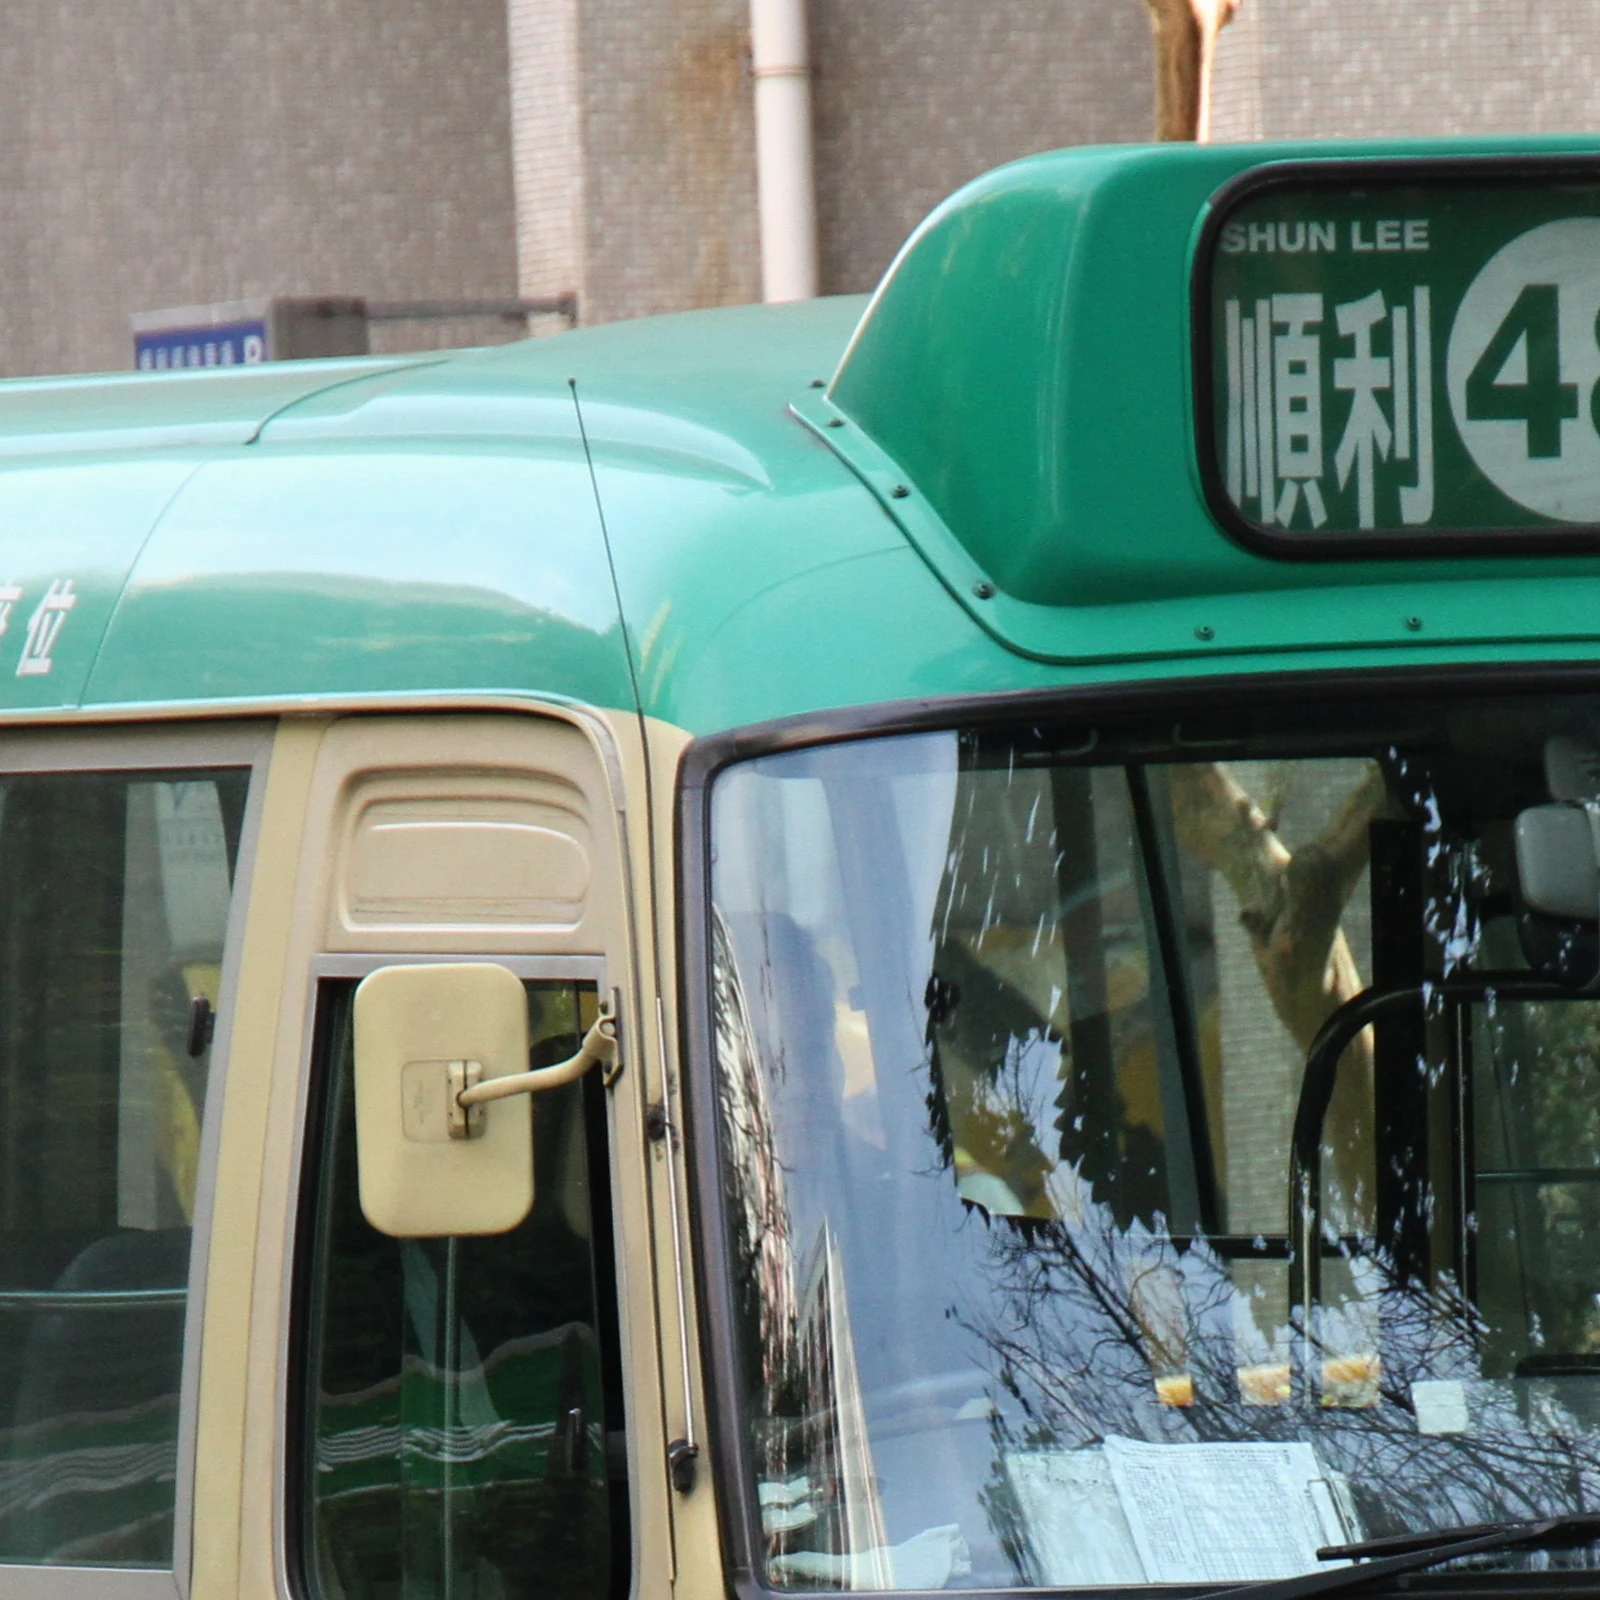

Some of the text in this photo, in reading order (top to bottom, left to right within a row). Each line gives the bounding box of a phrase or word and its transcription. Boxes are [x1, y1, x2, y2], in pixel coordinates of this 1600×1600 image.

[1220, 219, 1430, 255] SHUN LEE
[1224, 285, 1435, 531] 順利
